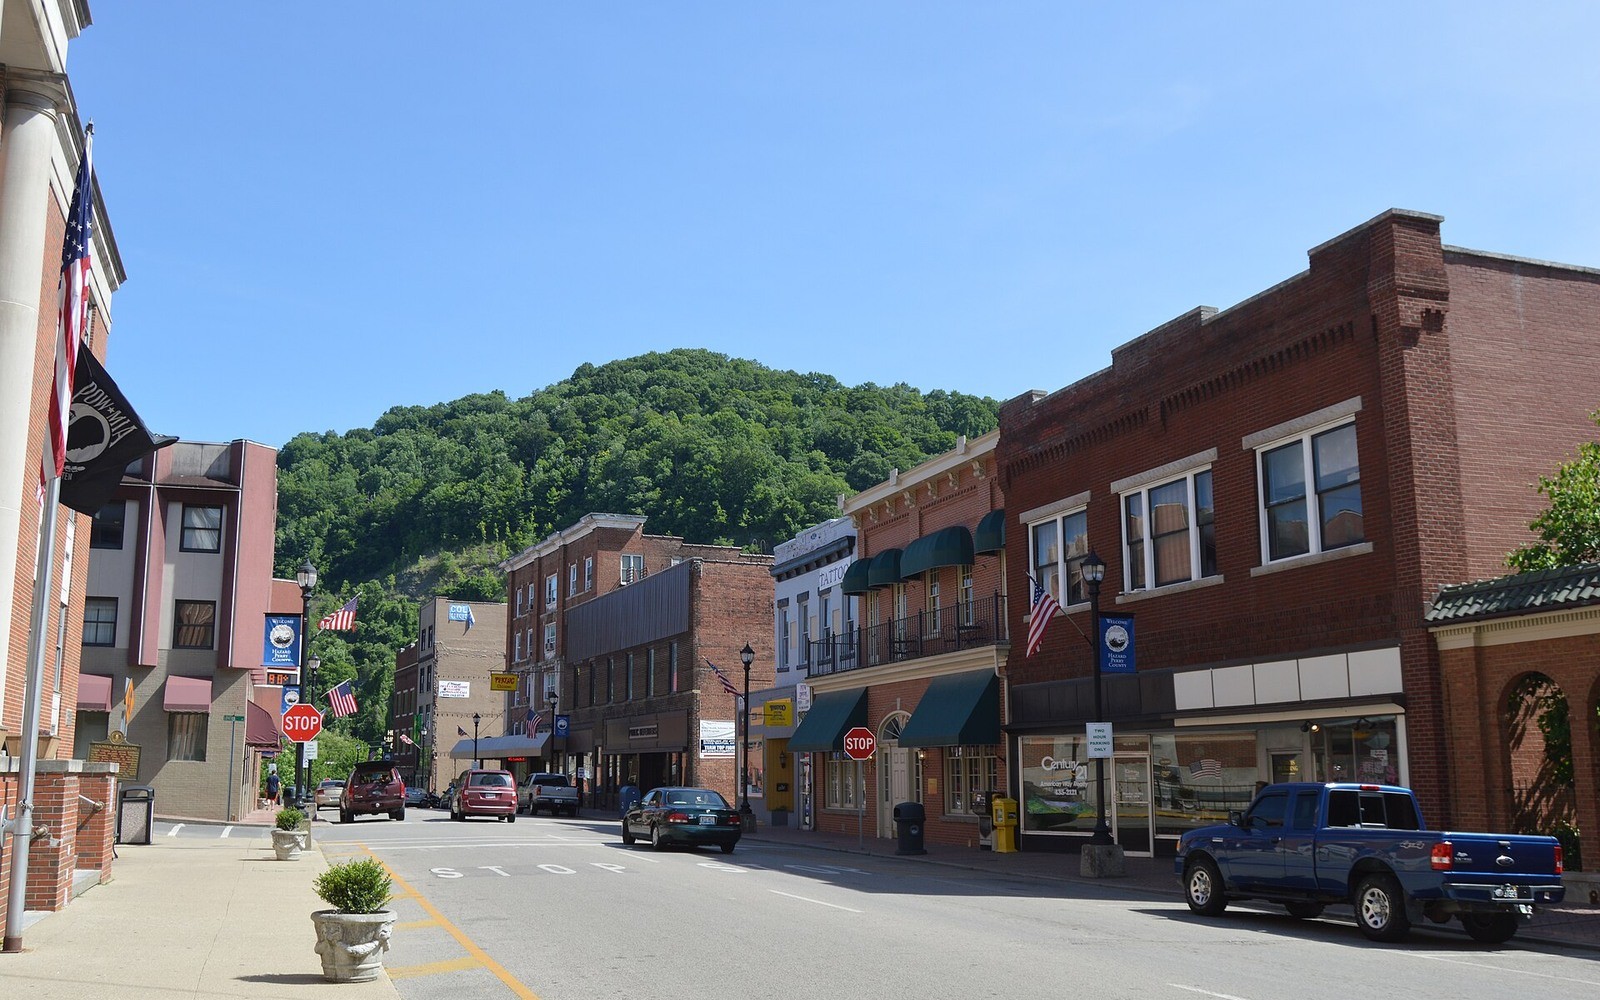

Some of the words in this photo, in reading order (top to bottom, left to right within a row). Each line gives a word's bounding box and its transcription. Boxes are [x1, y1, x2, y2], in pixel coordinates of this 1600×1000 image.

[819, 563, 849, 587] TATTO
[285, 715, 319, 731] STOP
[846, 737, 874, 750] STOP
[1041, 755, 1081, 771] Century
[1075, 765, 1088, 781] 21
[430, 861, 629, 879] STOP
